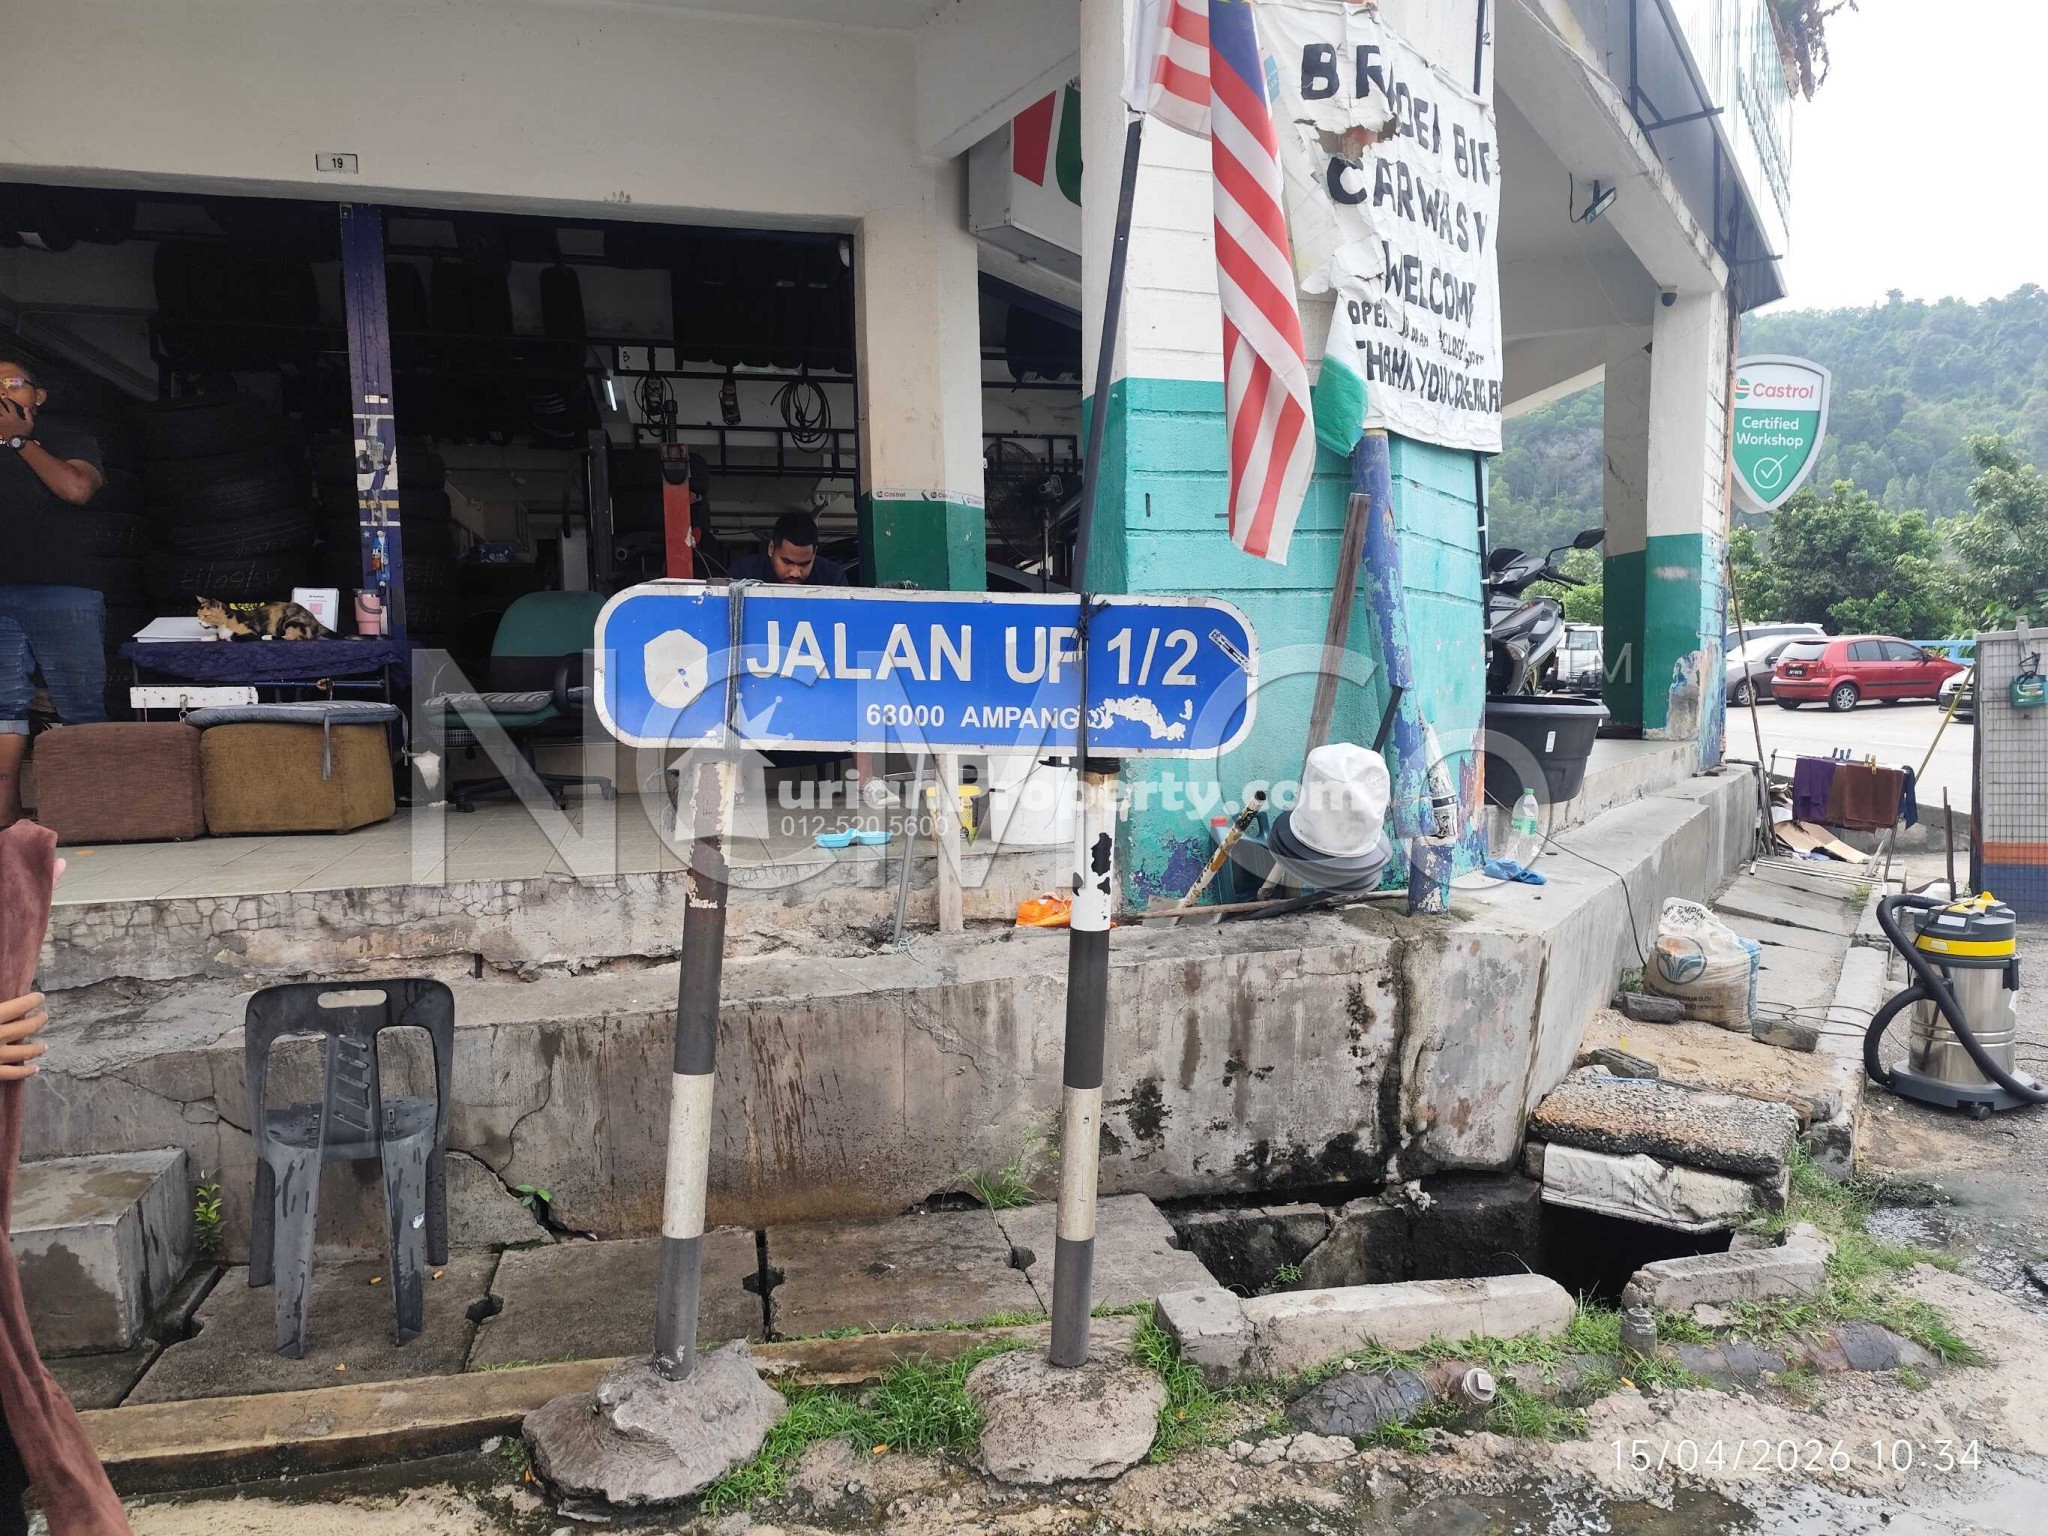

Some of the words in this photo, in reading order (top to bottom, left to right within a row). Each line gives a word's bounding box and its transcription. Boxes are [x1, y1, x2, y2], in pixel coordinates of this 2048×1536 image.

[331, 157, 344, 168] 19
[1753, 383, 1814, 399] Castrol
[1742, 416, 1799, 430] Certified
[1736, 432, 1804, 449] Workshop
[747, 619, 973, 683] JALAN
[1107, 628, 1199, 686] 1/2
[866, 704, 945, 728] 68000
[960, 707, 1080, 731] AMPANG
